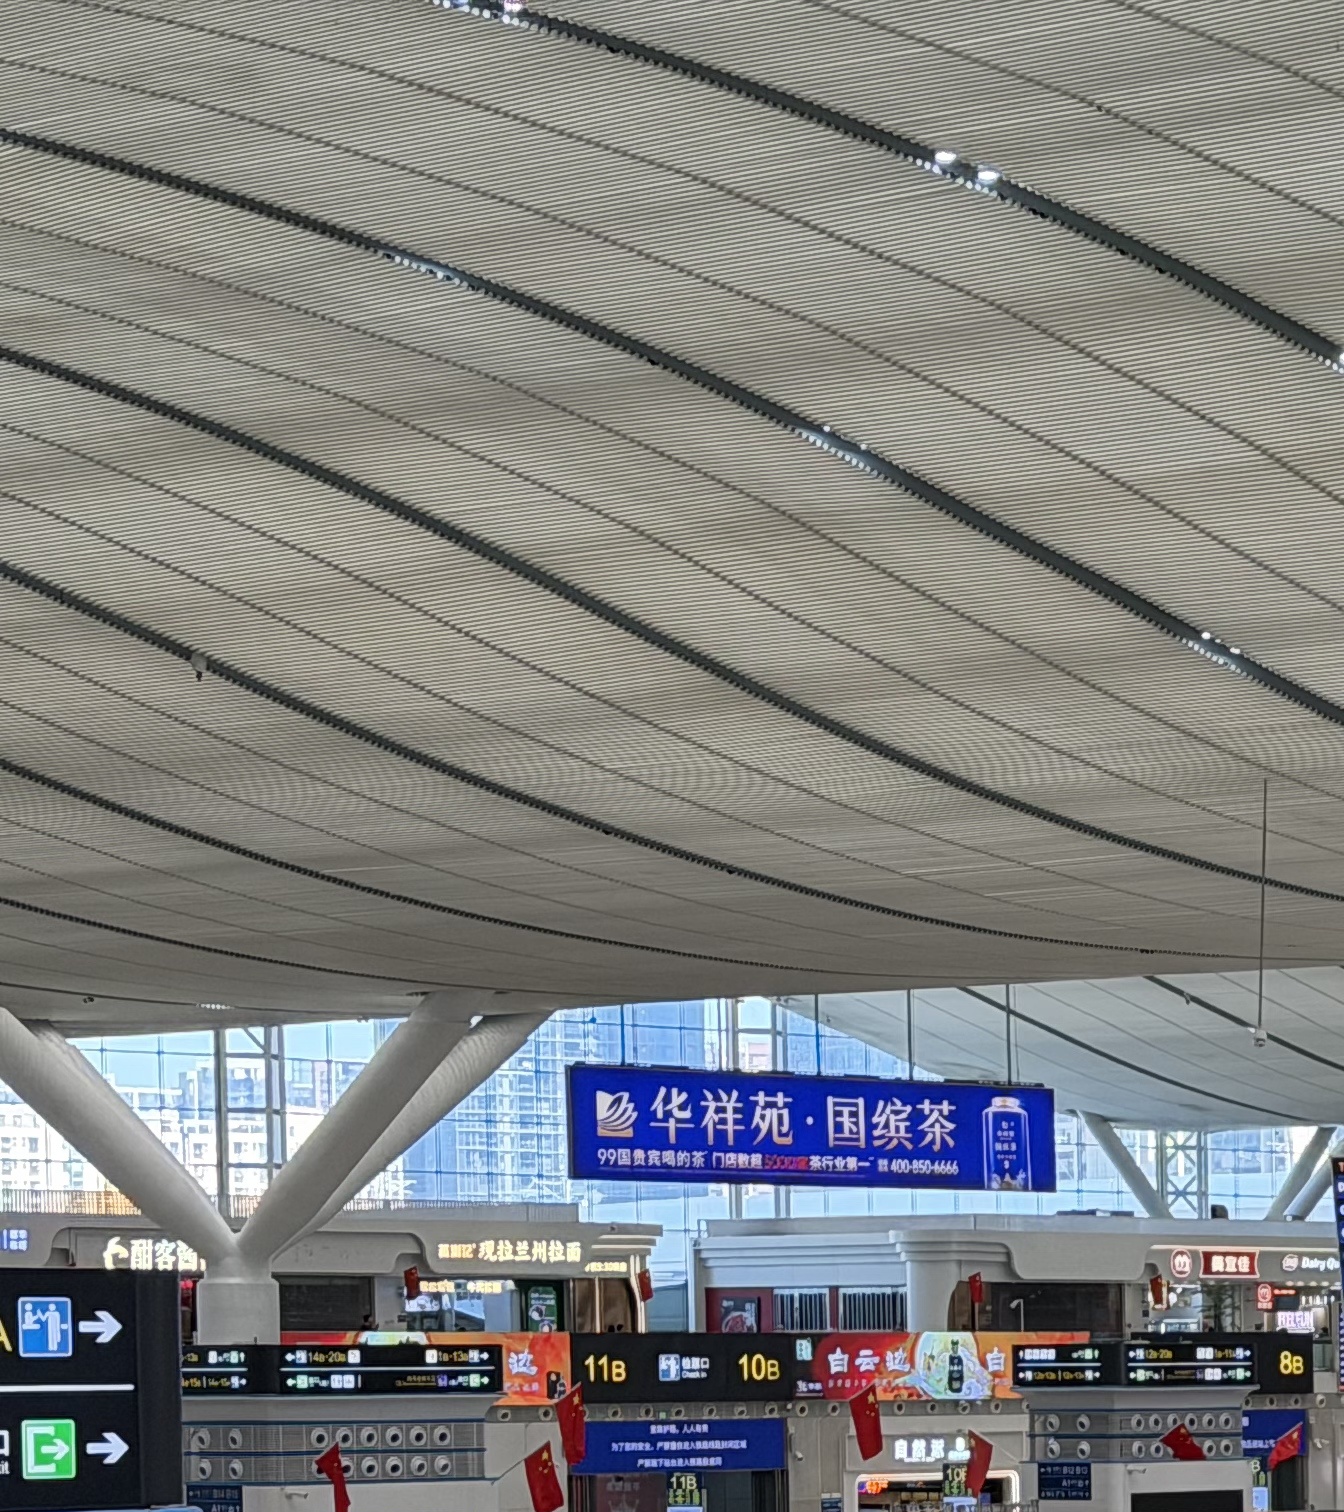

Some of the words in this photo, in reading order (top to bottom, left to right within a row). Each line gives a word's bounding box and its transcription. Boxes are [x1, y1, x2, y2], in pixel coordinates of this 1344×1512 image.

[1301, 1256, 1325, 1271] Dairy
[584, 1354, 626, 1383] 11B
[738, 1353, 781, 1382] 10B
[1279, 1350, 1304, 1375] 8B
[669, 1475, 698, 1490] 11B
